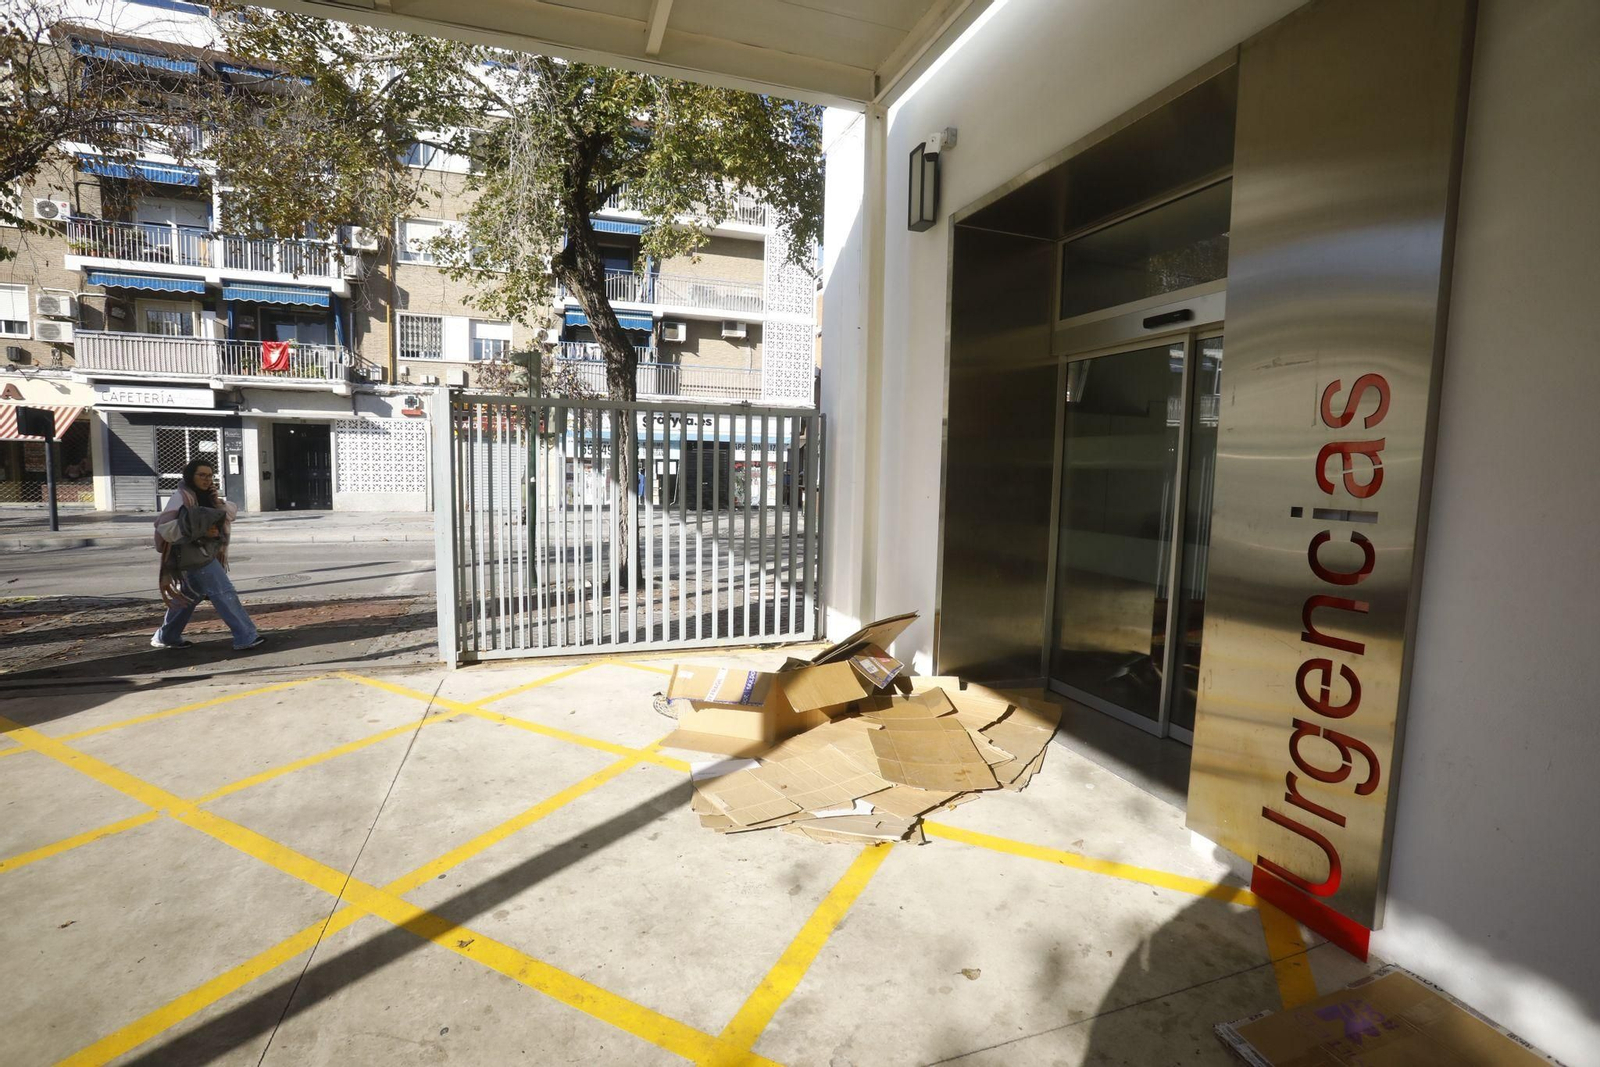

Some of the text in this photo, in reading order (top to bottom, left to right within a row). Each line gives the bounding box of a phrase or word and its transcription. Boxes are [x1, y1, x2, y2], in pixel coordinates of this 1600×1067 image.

[0, 382, 25, 401] A
[102, 390, 174, 404] CAFETERÍA
[1256, 372, 1391, 898] Urgencias
